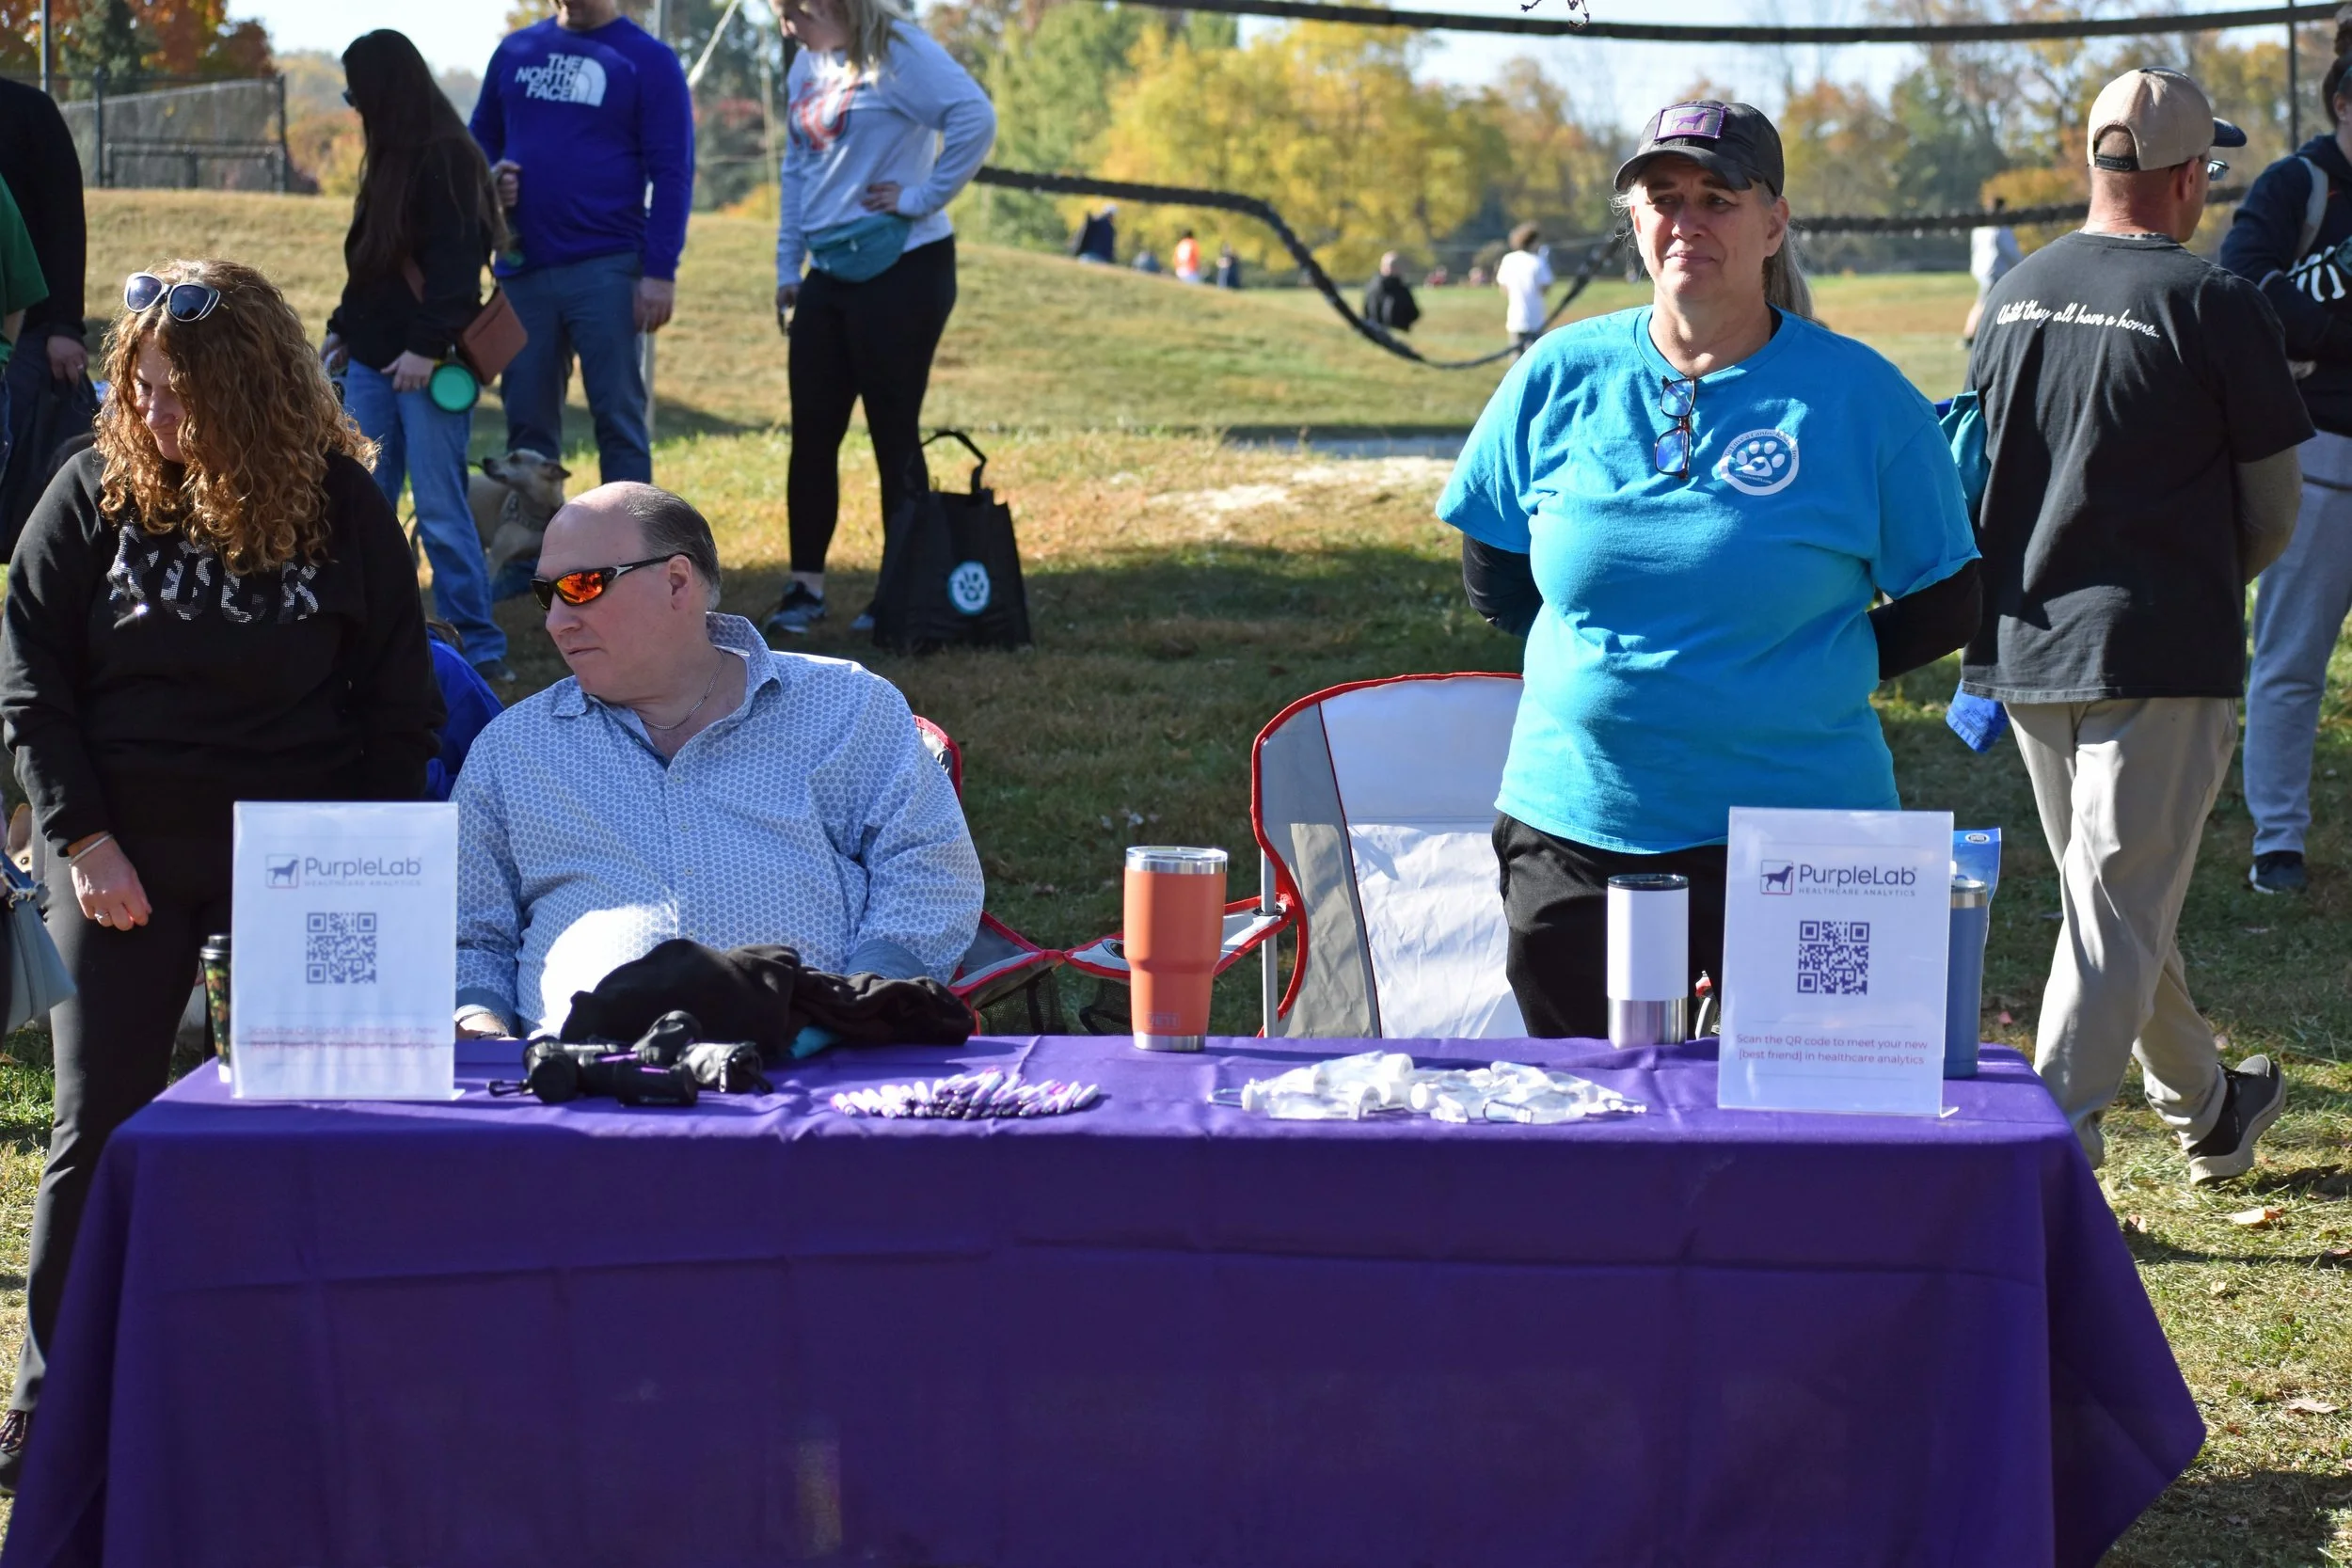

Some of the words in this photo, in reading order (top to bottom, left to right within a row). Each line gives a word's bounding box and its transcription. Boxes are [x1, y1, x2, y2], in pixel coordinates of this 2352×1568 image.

[548, 53, 583, 71] THE
[515, 66, 578, 88] NORTH
[525, 82, 570, 103] FACE
[1996, 301, 2024, 325] Until
[2023, 299, 2053, 328] they
[2053, 302, 2077, 323] all
[2074, 304, 2105, 325] have
[2105, 315, 2117, 326] a
[1799, 887, 1858, 895] HEALTHCARE
[1864, 888, 1916, 897] ANALYTICS
[1737, 1034, 1762, 1044] Scan
[1765, 1034, 1783, 1044] the
[1785, 1036, 1802, 1046] QR
[1804, 1036, 1831, 1046] code
[1834, 1037, 1845, 1046] to
[1847, 1037, 1875, 1048] meet
[1877, 1039, 1901, 1050] your
[1904, 1040, 1928, 1049] new
[1739, 1048, 1765, 1061] [best
[1768, 1049, 1803, 1062] friend]
[1805, 1050, 1816, 1060] in
[1818, 1050, 1875, 1063] healthcare
[1877, 1052, 1925, 1065] analytics
